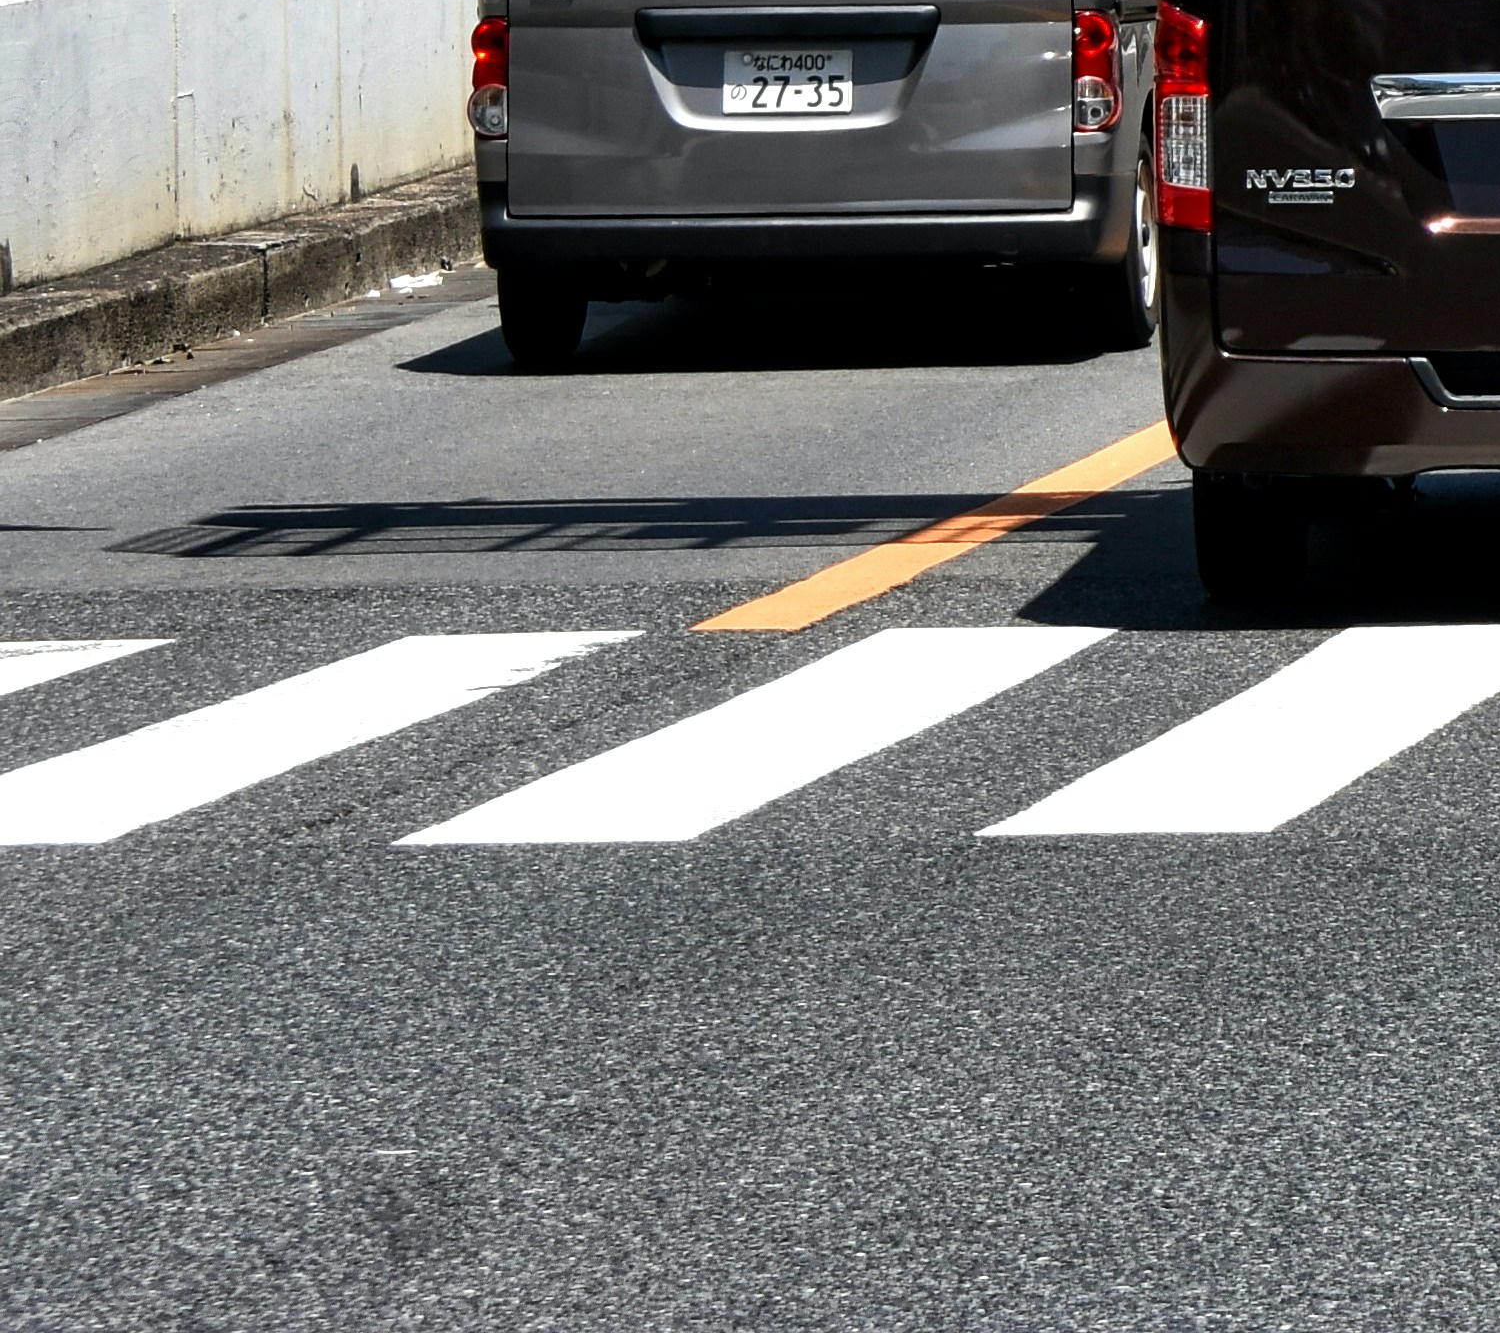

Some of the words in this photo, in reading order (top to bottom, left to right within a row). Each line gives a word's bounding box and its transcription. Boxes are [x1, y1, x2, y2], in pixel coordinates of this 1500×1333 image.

[753, 53, 827, 71] なにわ400
[730, 84, 748, 102] の
[752, 74, 846, 109] 27-35
[1246, 169, 1356, 189] NV350
[1272, 193, 1328, 201] CARAVAN
